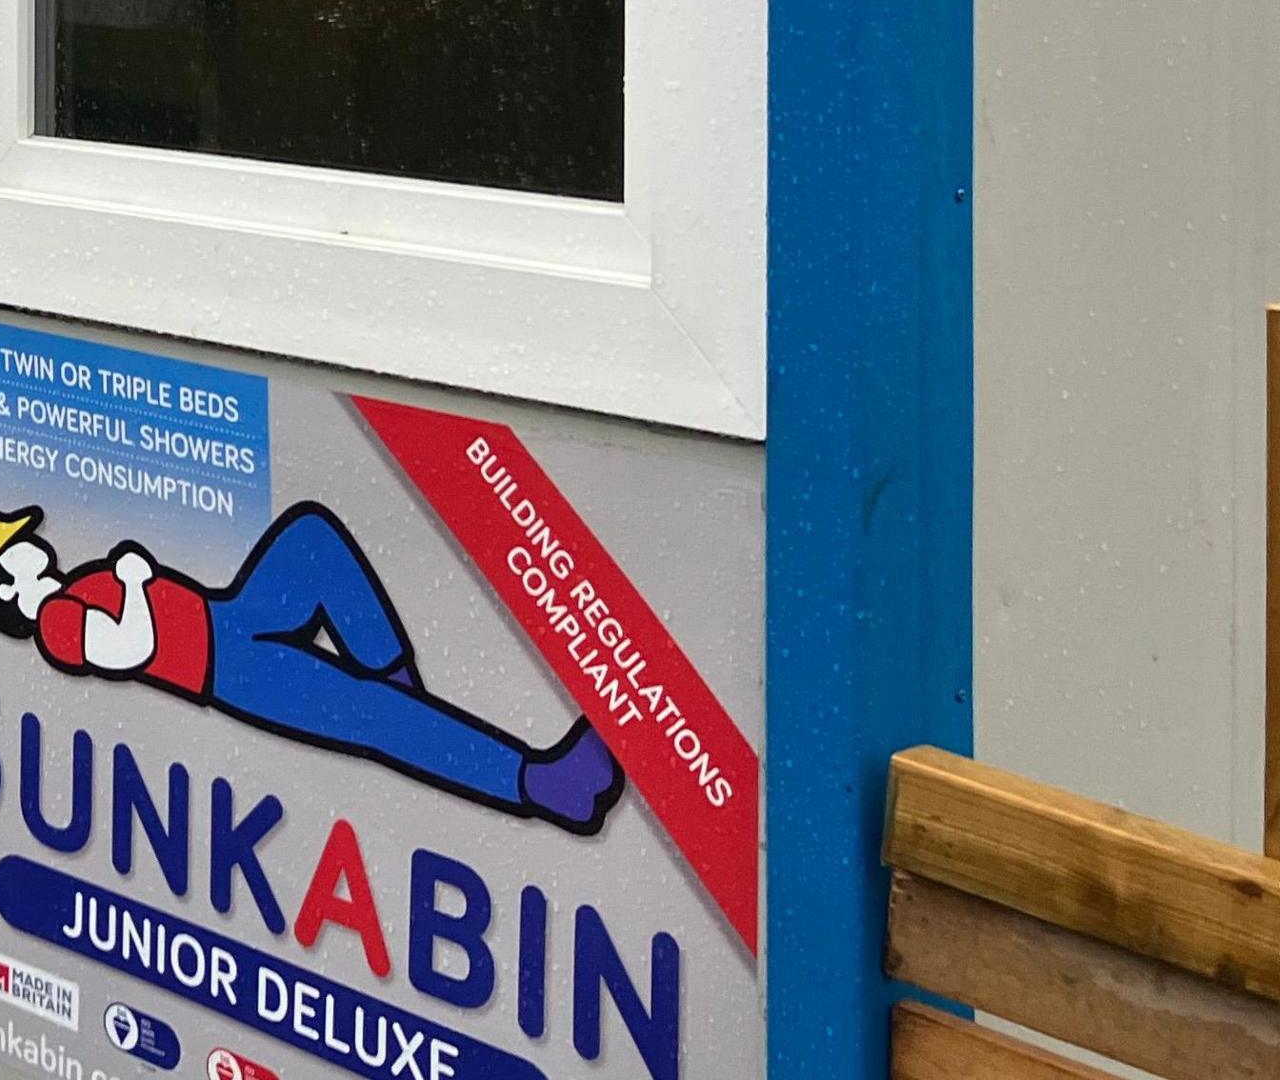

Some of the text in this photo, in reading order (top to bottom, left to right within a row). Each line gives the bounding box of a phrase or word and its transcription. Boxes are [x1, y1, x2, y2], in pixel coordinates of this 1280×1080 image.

[1, 347, 53, 382] TWIN
[60, 362, 91, 390] OR
[98, 369, 171, 408] TRIPLE
[180, 387, 239, 423] BEDS
[17, 396, 133, 446] POWERFUL
[140, 427, 254, 473] SHOWERS
[65, 454, 233, 517] CONSUMPTION
[465, 437, 732, 807] BUILDING REGULATIONS
[506, 546, 643, 727] COMPLIANT
[12, 967, 72, 1002] MADE IN
[62, 891, 238, 1006] JUNIOR
[12, 986, 72, 1019] BRITAIN
